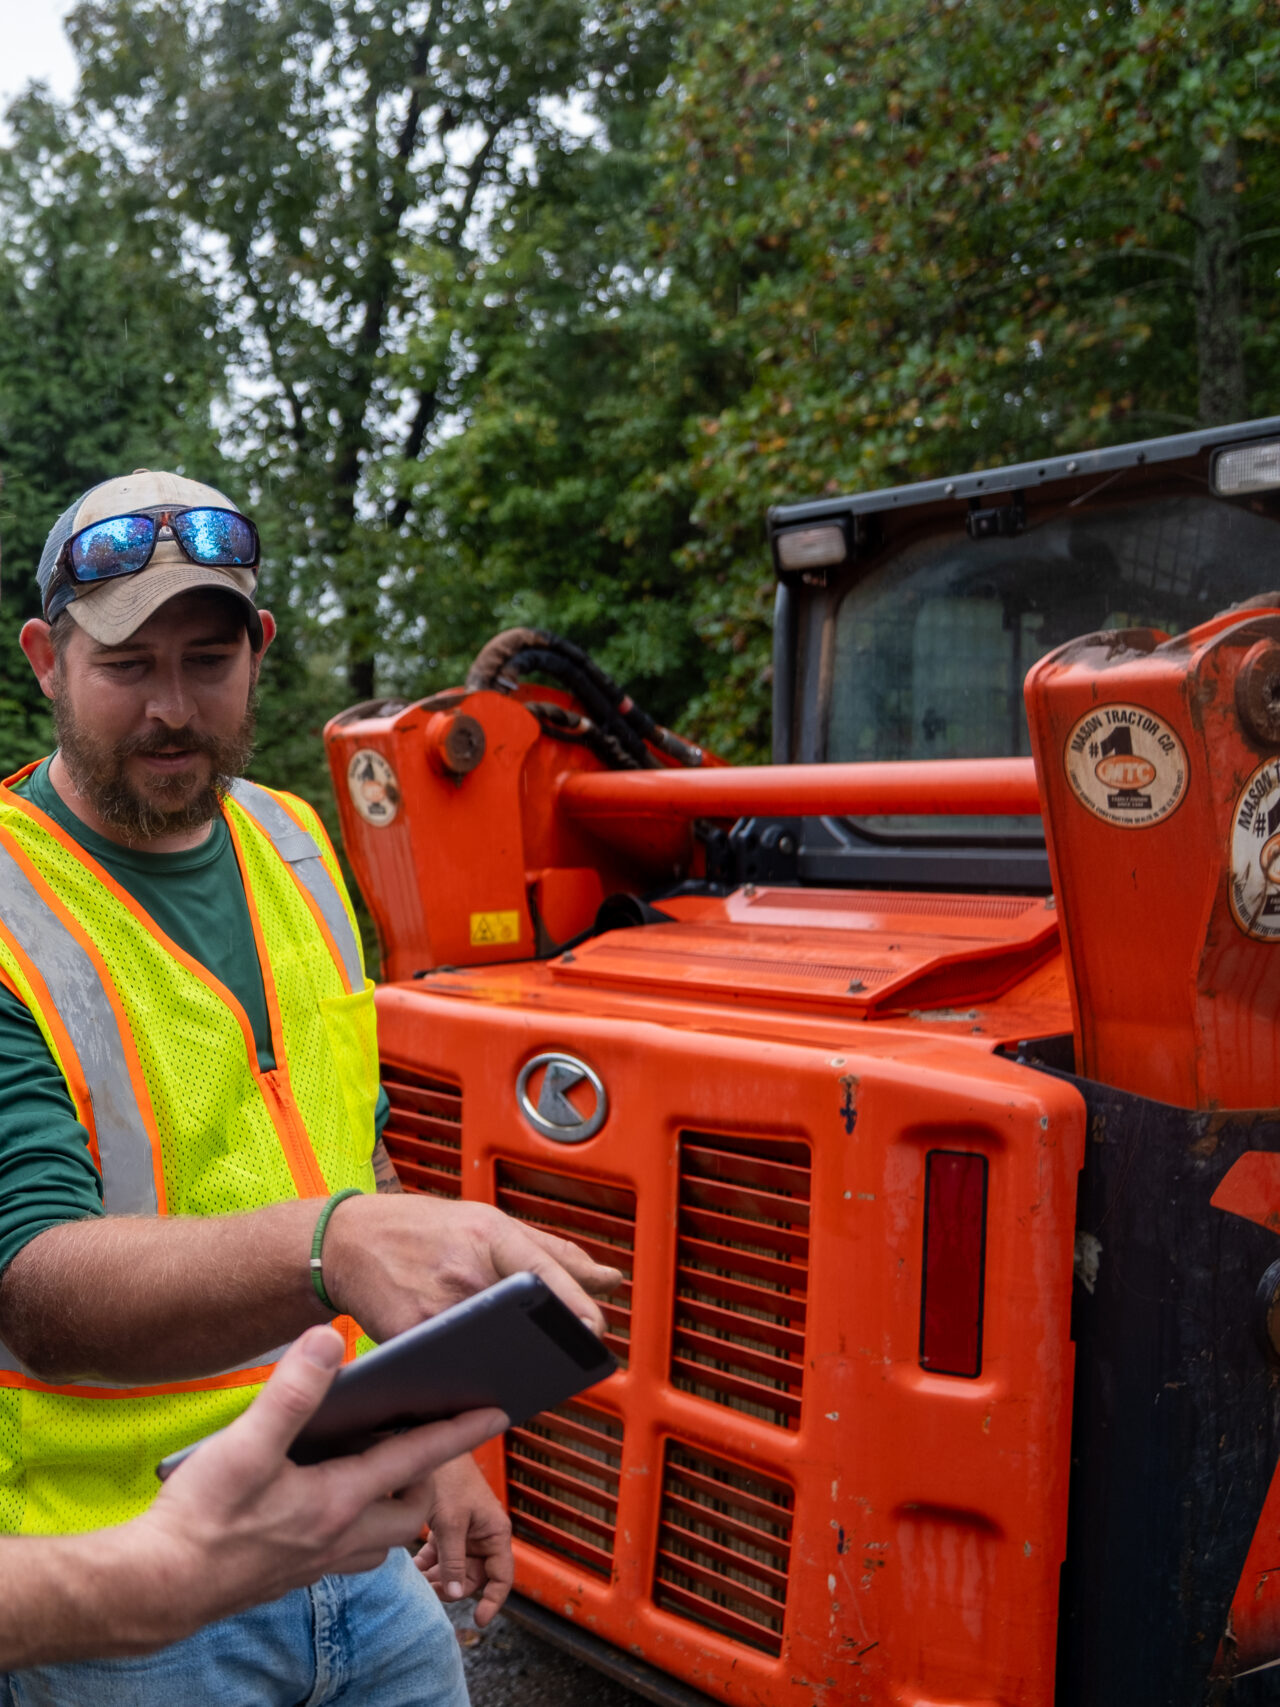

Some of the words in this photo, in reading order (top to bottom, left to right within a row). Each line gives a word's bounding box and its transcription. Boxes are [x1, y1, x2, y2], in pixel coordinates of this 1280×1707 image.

[1071, 714, 1103, 753] MASON
[1104, 709, 1160, 736] TRACTOR
[1157, 733, 1176, 756] CO.
[1101, 762, 1152, 784] MTC
[1238, 770, 1272, 831] MASON
